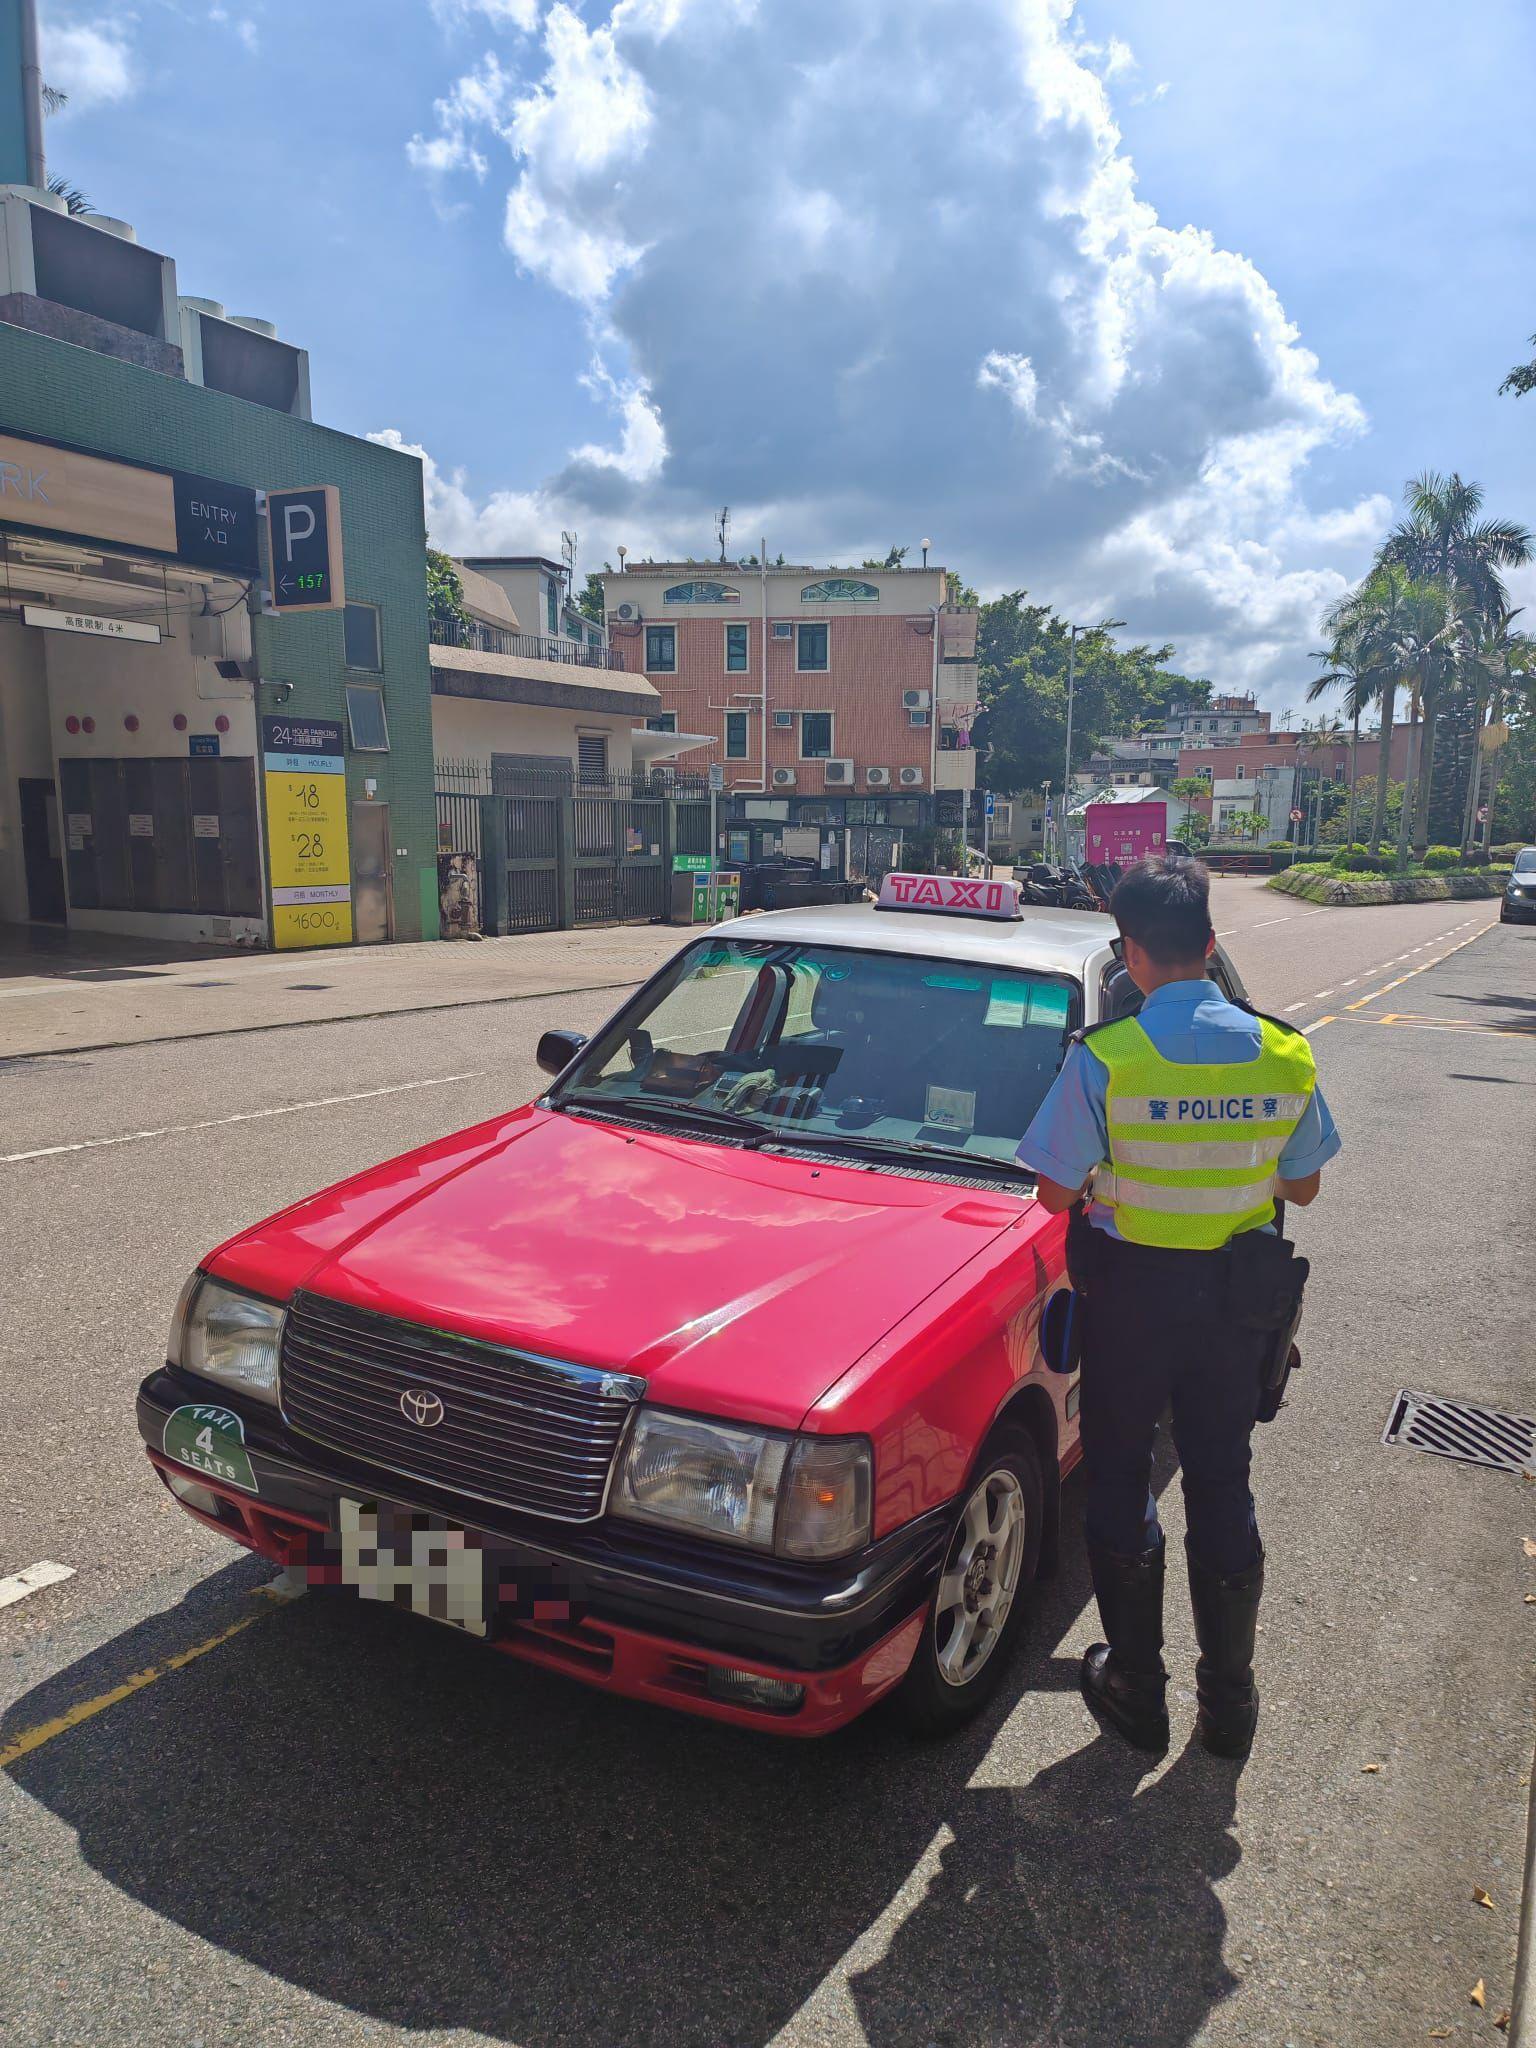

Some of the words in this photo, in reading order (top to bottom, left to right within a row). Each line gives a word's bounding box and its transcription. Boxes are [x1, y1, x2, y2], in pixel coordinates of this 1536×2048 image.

[191, 501, 238, 525] ENTRY
[203, 527, 228, 545] 入口
[284, 504, 316, 562] P
[298, 573, 324, 589] 157
[64, 615, 104, 632] 高度限制
[272, 725, 293, 744] 24
[292, 727, 310, 736] HOUR
[310, 728, 338, 737] PARKING
[308, 759, 334, 768] HOURLY
[986, 796, 993, 813] P
[310, 890, 339, 898] MONTHLY
[890, 876, 1003, 911] TAXI
[1148, 1100, 1169, 1121] 警
[1178, 1098, 1254, 1120] POLICE
[1263, 1098, 1278, 1118] 察
[193, 1407, 235, 1430] TAXI
[195, 1426, 214, 1455] 4
[180, 1447, 236, 1479] SEATS
